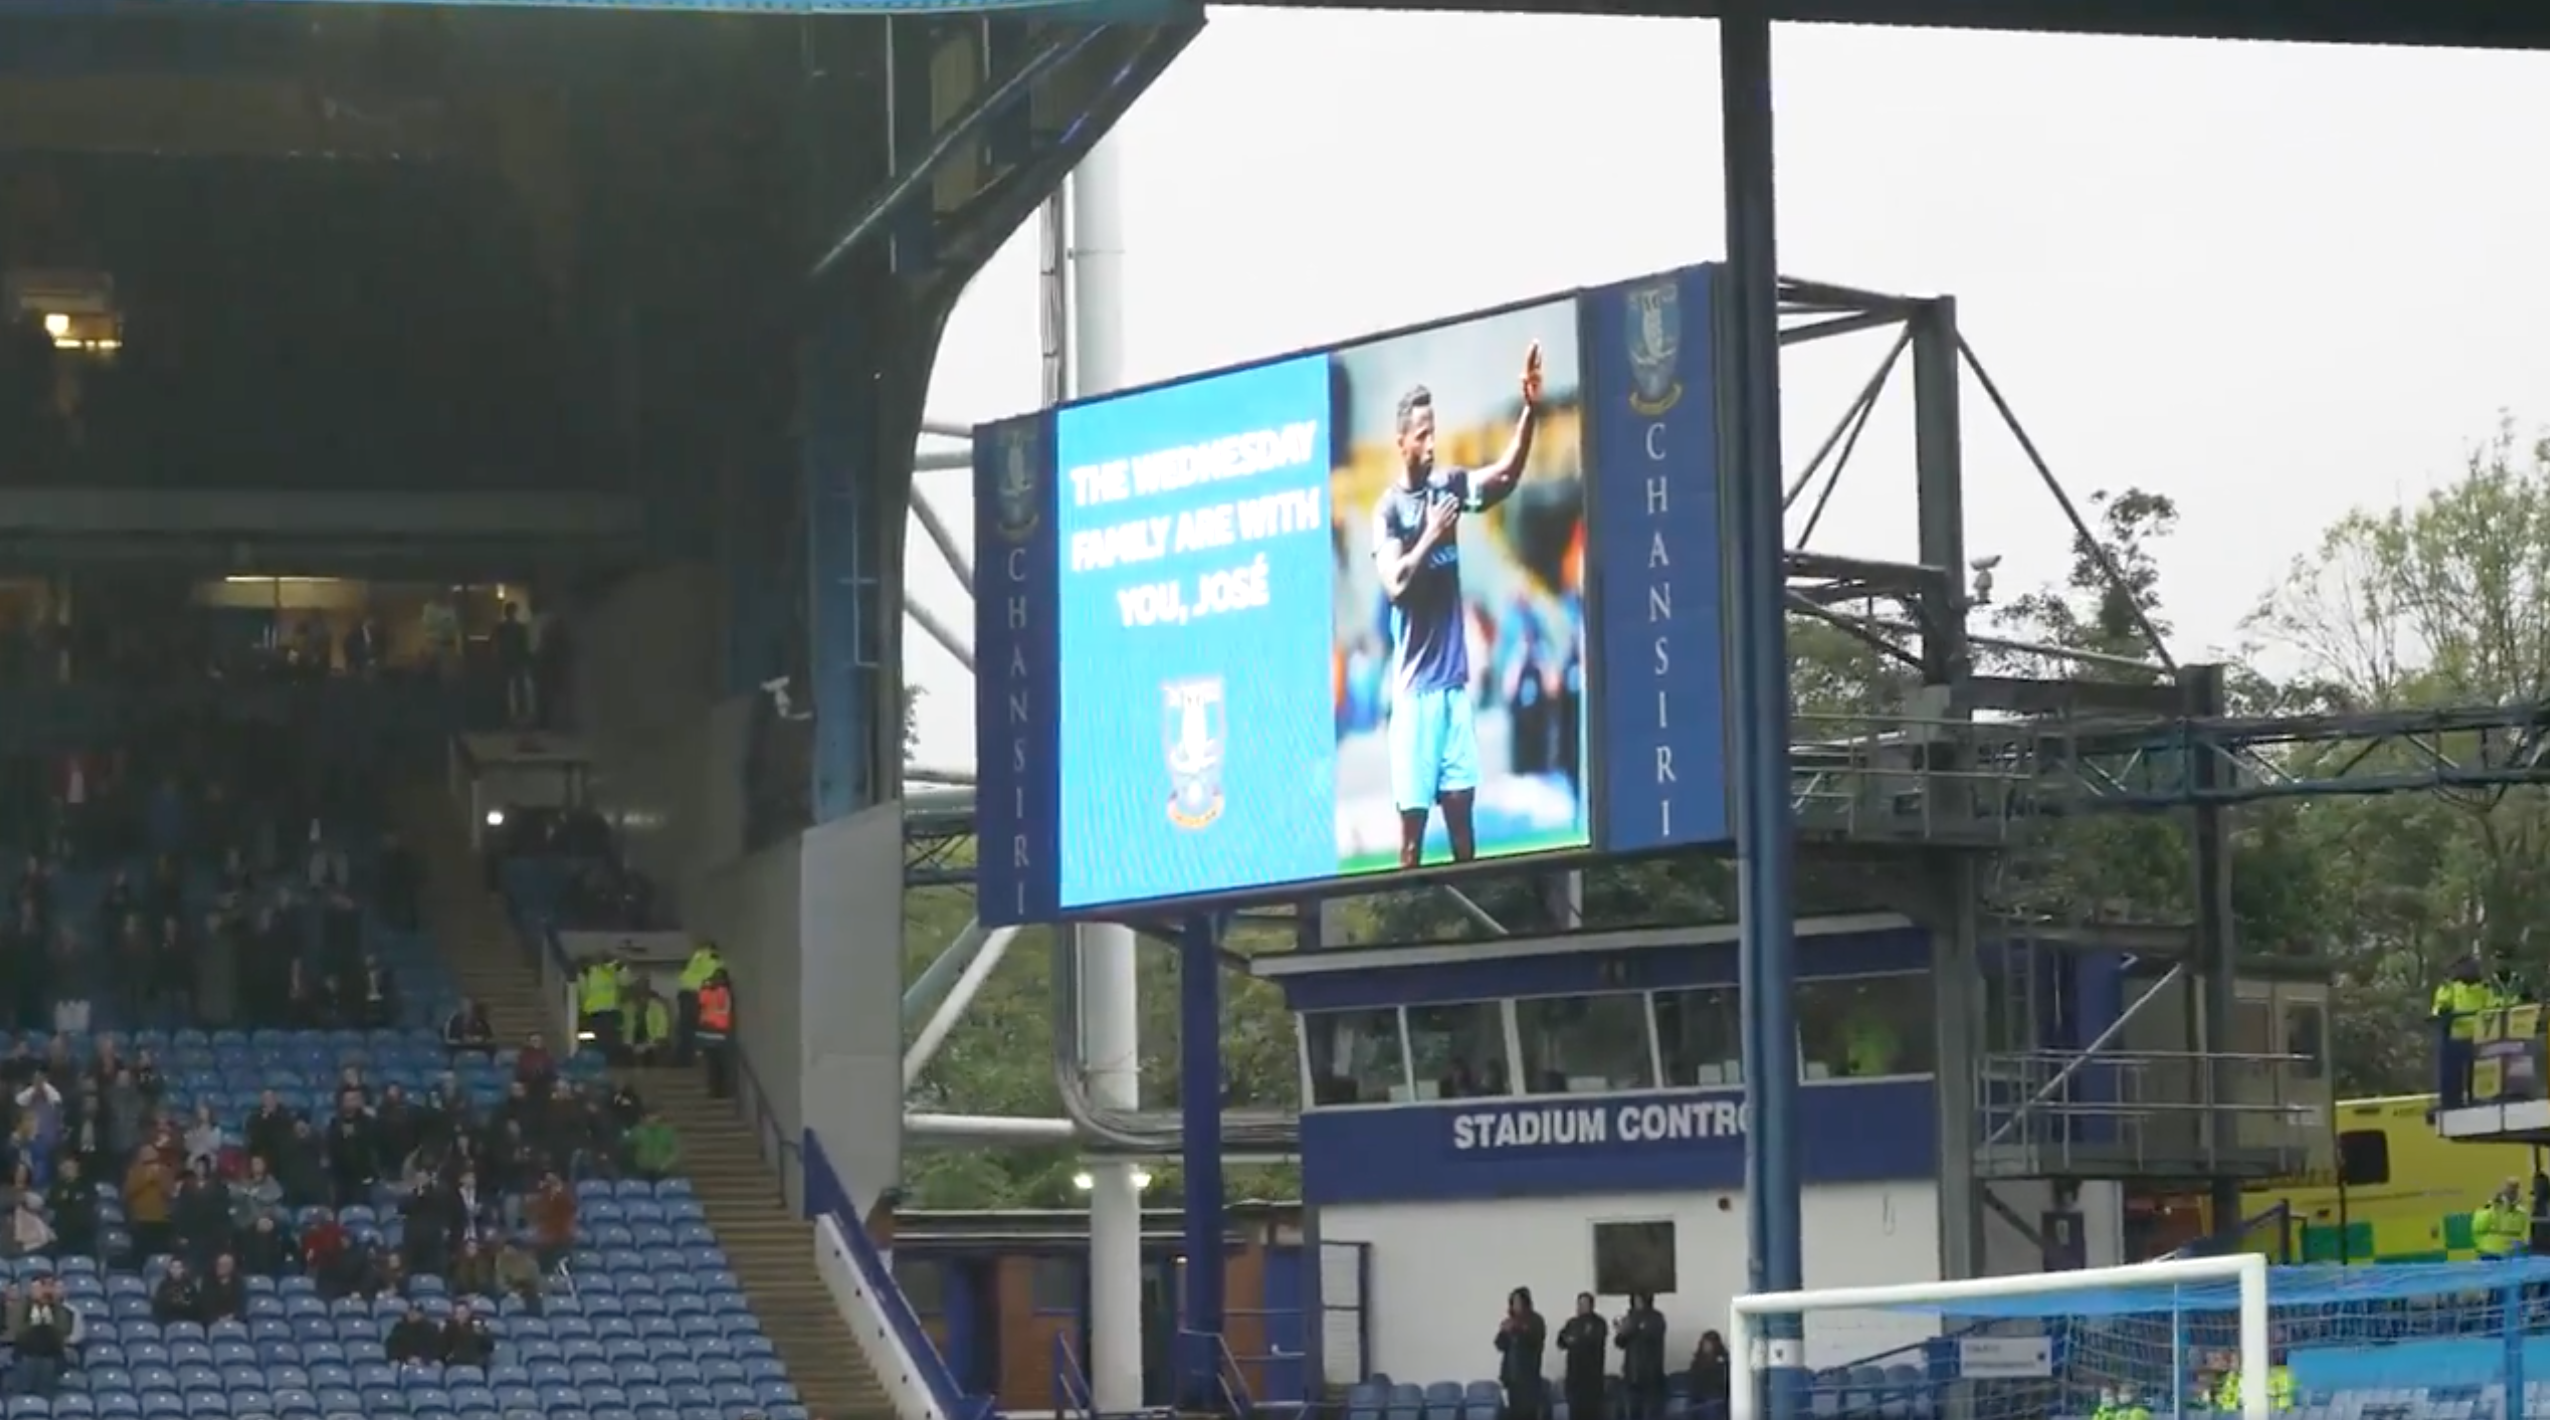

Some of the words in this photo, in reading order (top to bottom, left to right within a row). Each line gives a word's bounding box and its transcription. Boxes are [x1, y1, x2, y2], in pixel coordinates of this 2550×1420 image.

[1070, 460, 1130, 506] THE
[1131, 420, 1317, 496] WEDNESDAY
[1072, 516, 1171, 572] FAMILY
[1175, 504, 1236, 553] ARE
[1237, 487, 1321, 540] WITH
[1117, 580, 1188, 626] YOU,
[1193, 552, 1269, 617] JOSÉ
[1646, 422, 1676, 837] CHANSIRI
[1007, 547, 1030, 916] CHANSIRI
[1454, 1108, 1606, 1149] STADIUM
